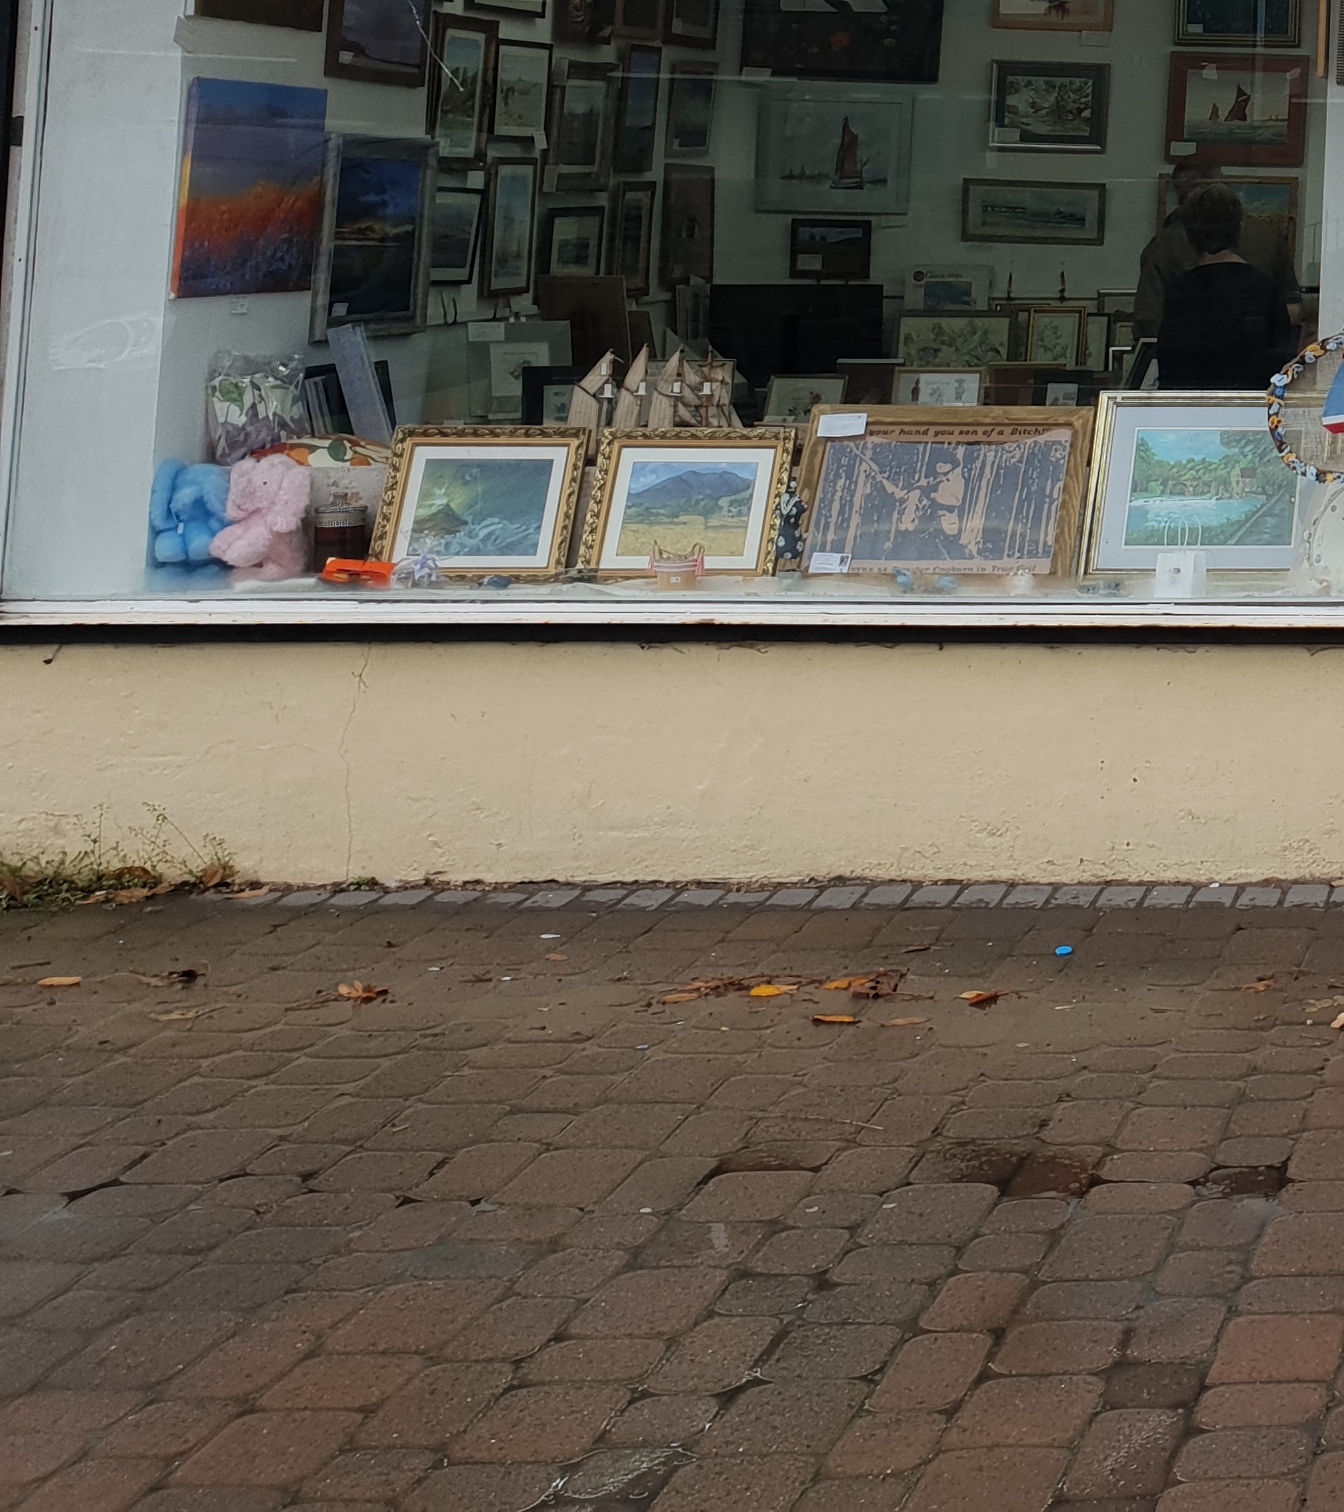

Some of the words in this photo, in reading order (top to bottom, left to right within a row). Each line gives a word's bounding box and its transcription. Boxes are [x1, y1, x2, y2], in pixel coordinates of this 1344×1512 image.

[868, 428, 896, 437] your
[898, 427, 929, 436] hand
[933, 429, 954, 437] you
[982, 427, 994, 437] of
